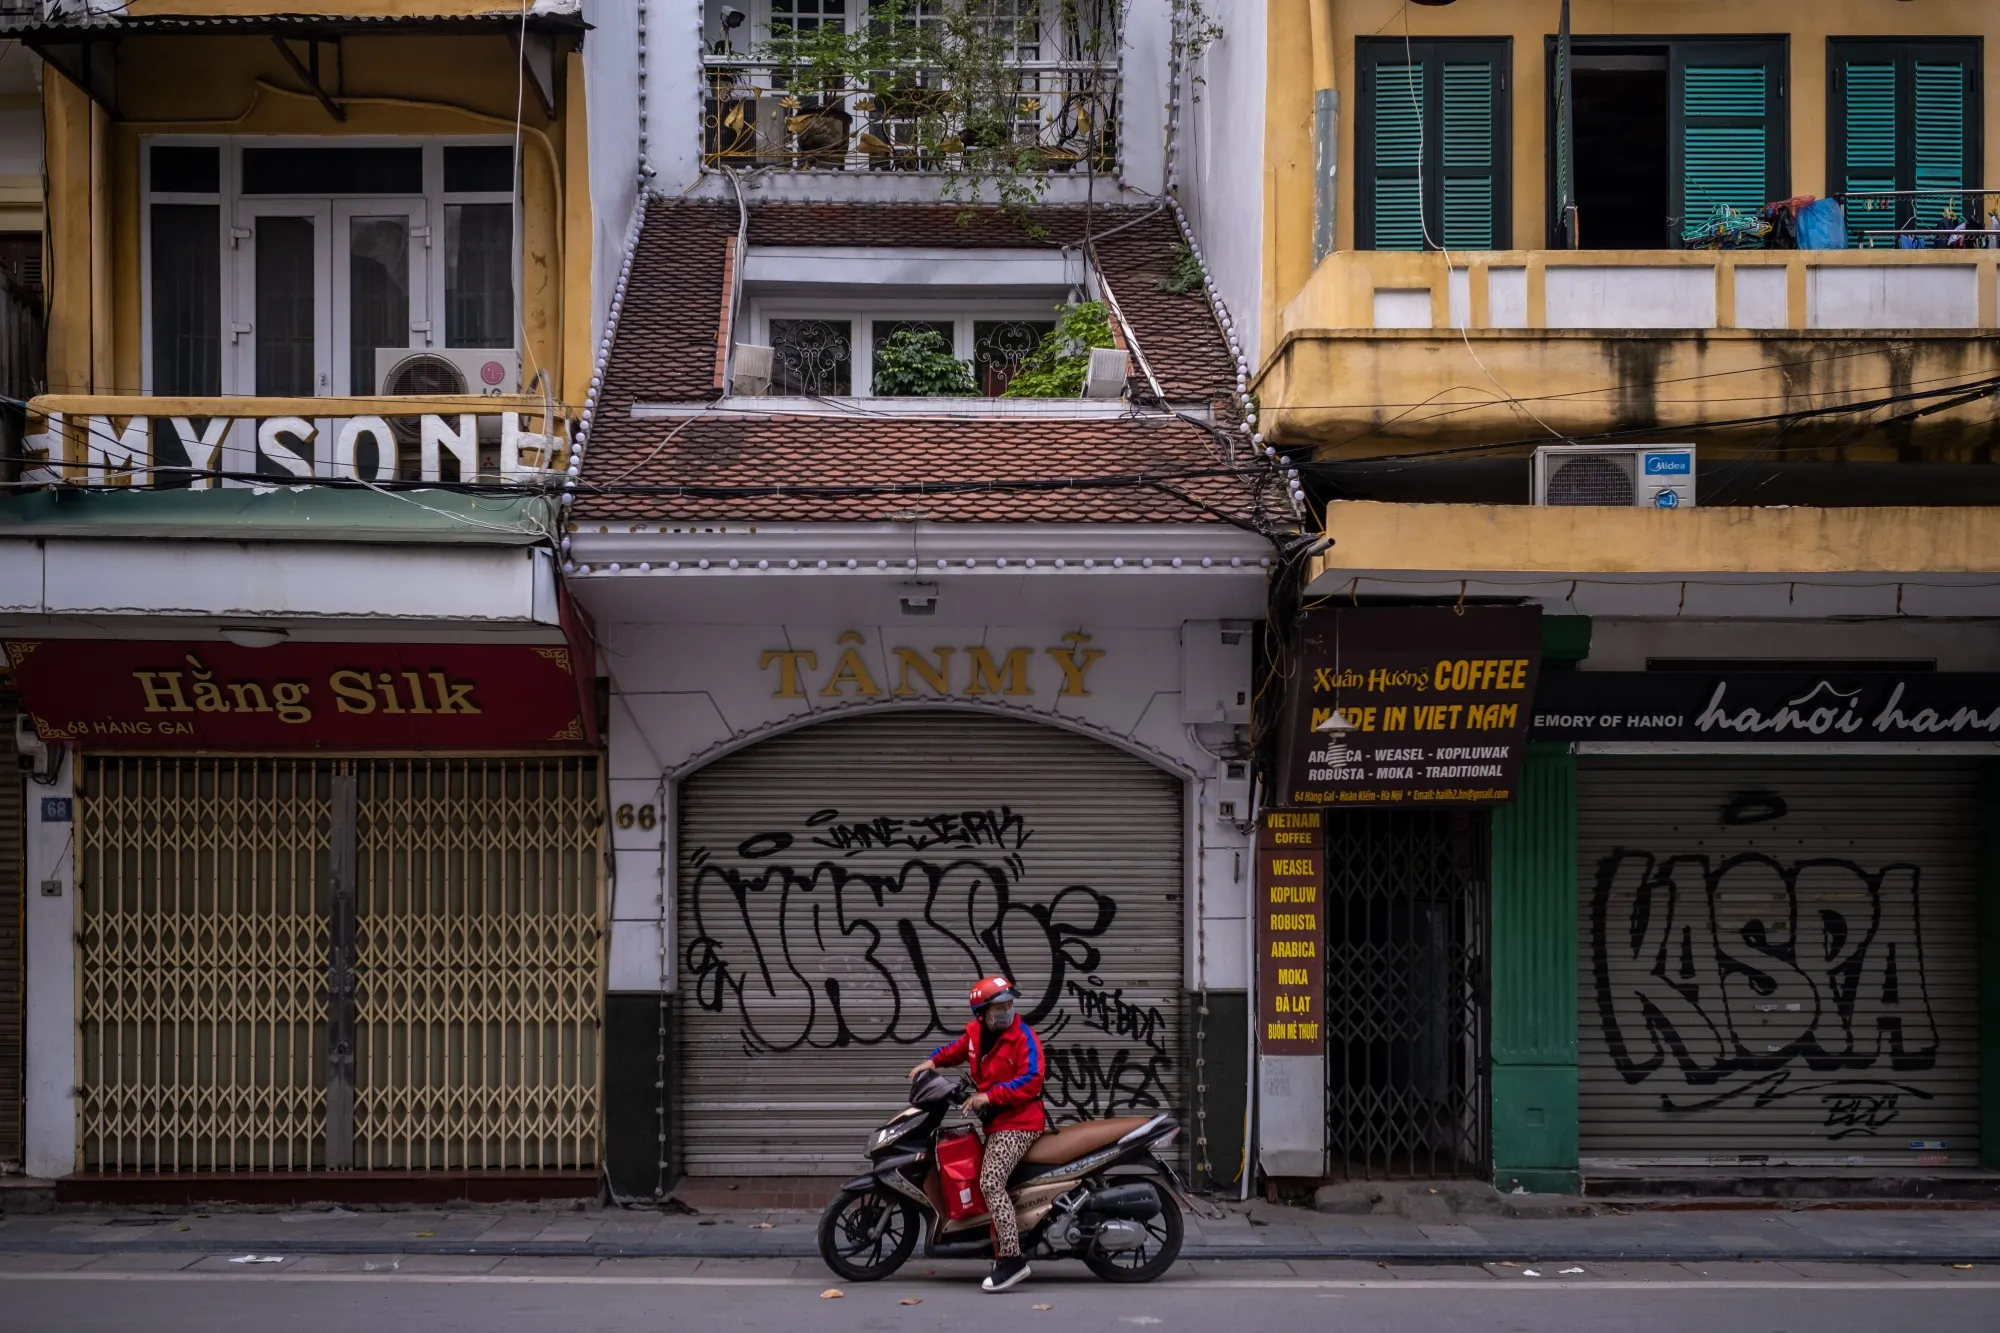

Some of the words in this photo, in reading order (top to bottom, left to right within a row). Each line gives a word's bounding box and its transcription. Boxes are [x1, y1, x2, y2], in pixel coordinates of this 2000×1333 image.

[1651, 459, 1686, 471] Midea
[1434, 658, 1529, 691] COFFEE
[132, 653, 312, 724] Hằng
[329, 669, 482, 715] Silk
[67, 720, 90, 735] 68
[94, 715, 152, 735] HÀNG
[158, 720, 195, 735] GAI
[1382, 705, 1408, 732] IN
[1413, 704, 1463, 731] VIET
[1466, 702, 1518, 732] NAM
[1599, 714, 1623, 728] OF
[1627, 714, 1684, 728] HANOI
[1307, 749, 1363, 763] ARCA
[1374, 747, 1425, 761] WEASEL
[1436, 745, 1510, 760] KOPILUWAK
[1308, 767, 1365, 781] ROBUSTA
[1376, 766, 1414, 780] MOKA
[1425, 764, 1504, 779] TRADITIONAL
[47, 801, 67, 817] 68
[615, 803, 657, 830] 66
[1267, 812, 1320, 829] VIETNAM
[1275, 832, 1312, 844] COFFEE
[1272, 859, 1315, 876] WEASEL
[1270, 886, 1317, 903] KOPILUW
[1270, 914, 1317, 931] ROBUSTA
[1271, 941, 1316, 958] ARABICA
[1278, 968, 1309, 985] MOKA
